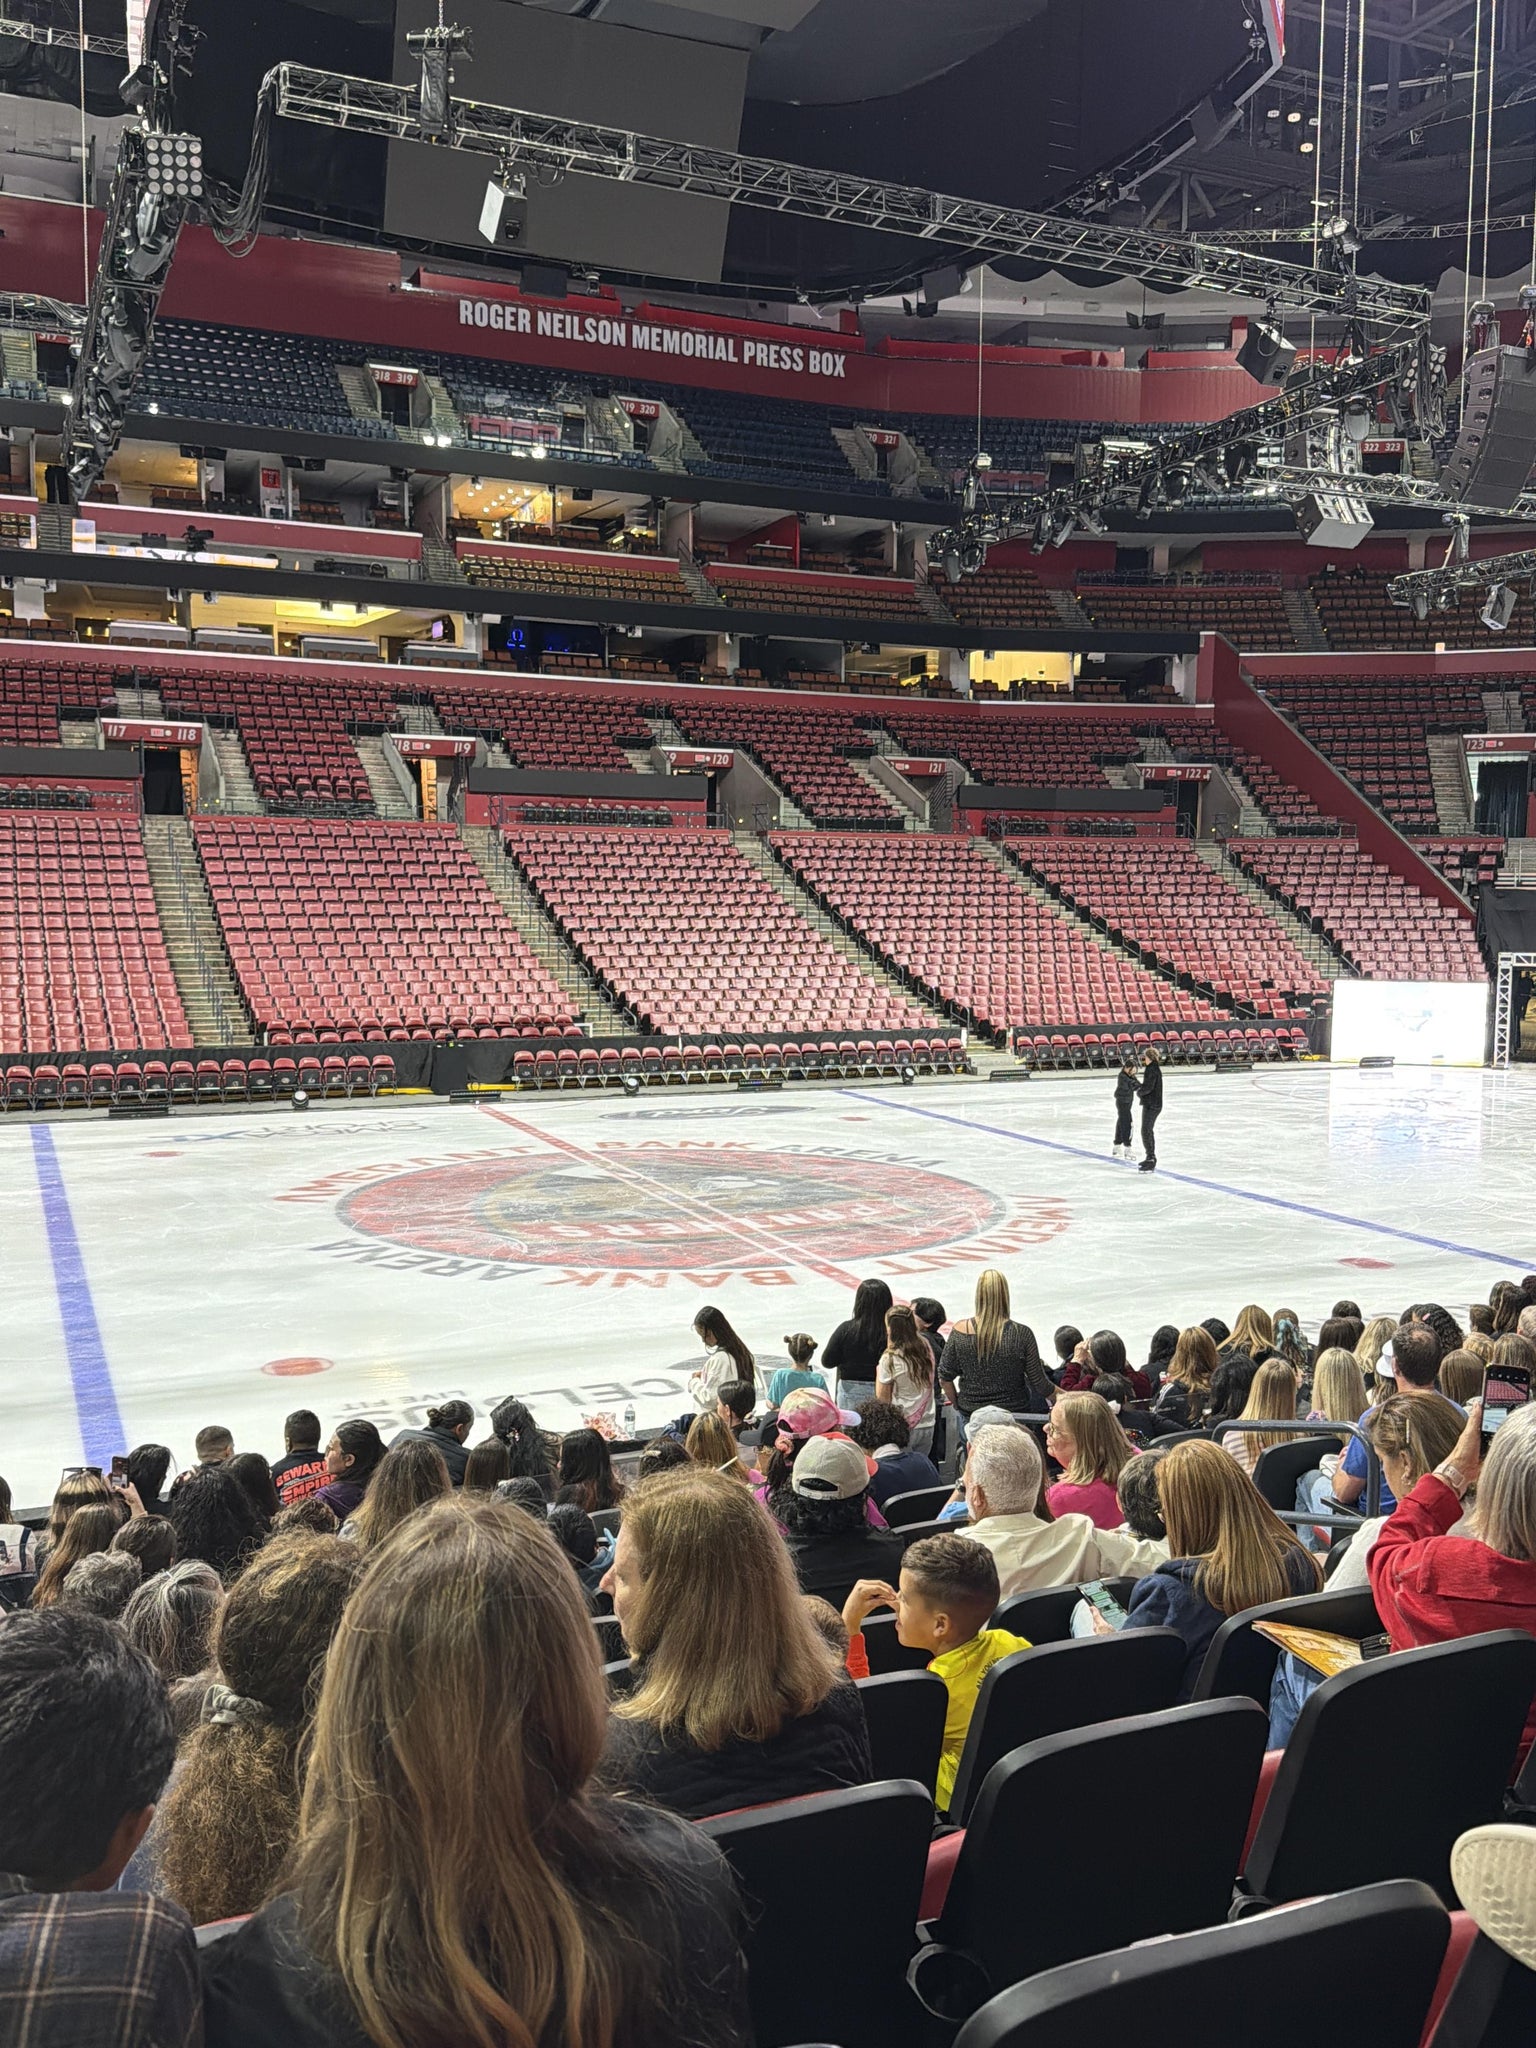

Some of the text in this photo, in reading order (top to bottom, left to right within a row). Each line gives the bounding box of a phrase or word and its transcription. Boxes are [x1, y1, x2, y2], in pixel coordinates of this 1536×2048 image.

[459, 300, 846, 378] ROGER NEILSON MEMORIAL PRESS BOX
[374, 370, 413, 384] 318 319
[640, 404, 655, 415] 320
[883, 434, 897, 445] 321
[1363, 443, 1401, 452] 322 323
[107, 725, 127, 737] 117
[177, 728, 197, 741] 118
[454, 742, 471, 754] 119
[1466, 739, 1484, 750] 123
[712, 754, 729, 765] 120
[928, 762, 942, 774] 121
[1141, 768, 1156, 779] 121
[1185, 768, 1202, 779] 122
[594, 1140, 761, 1150] BANK
[310, 1238, 545, 1281] ARENA
[544, 1269, 798, 1289] BANK
[342, 1390, 466, 1412] LIVE FIT
